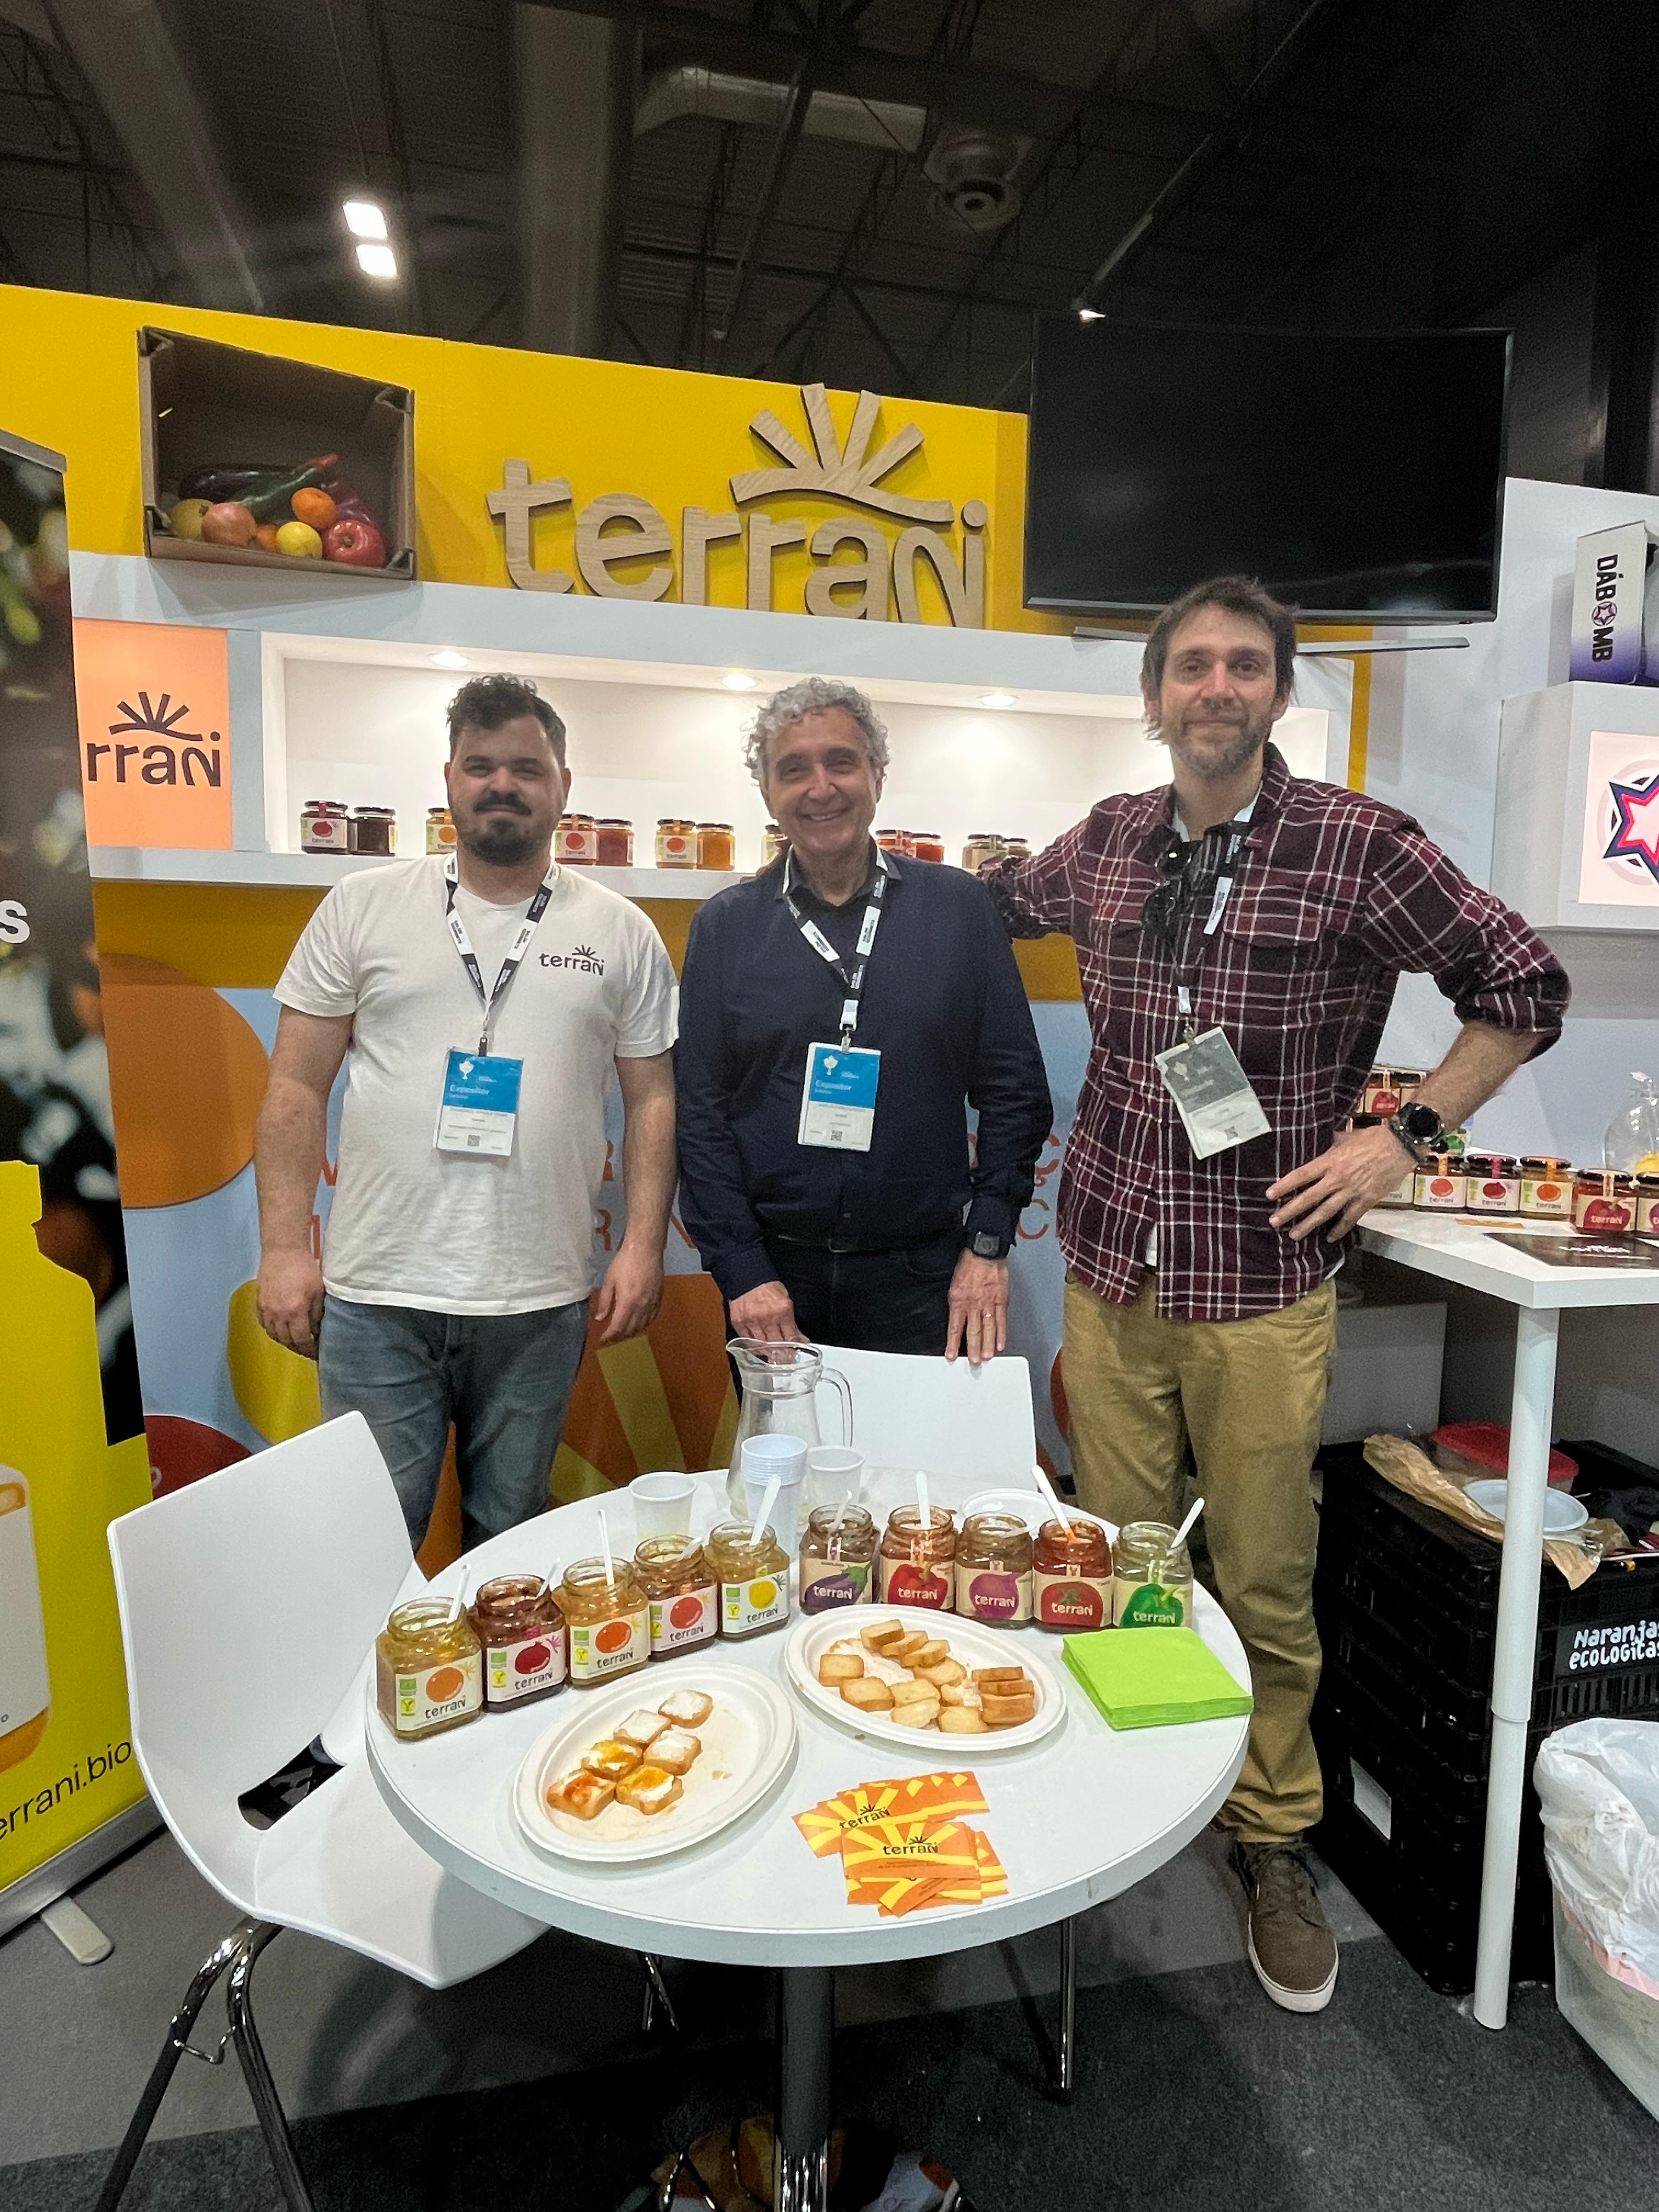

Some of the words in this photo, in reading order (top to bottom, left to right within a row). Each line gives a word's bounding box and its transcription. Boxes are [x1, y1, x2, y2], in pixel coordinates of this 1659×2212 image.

[487, 458, 988, 629] terrani
[539, 952, 604, 976] terrani
[1591, 1215, 1623, 1224] terrani
[813, 1585, 853, 1599] terrani
[898, 1588, 938, 1600] terrani
[974, 1594, 1015, 1607] terrani
[747, 1604, 778, 1622] terrani
[1051, 1602, 1093, 1616] terrani
[1133, 1610, 1176, 1624] terrani
[670, 1622, 703, 1641] terrani
[1573, 1620, 1659, 1649] Naranja
[597, 1647, 633, 1668] terrani
[515, 1668, 553, 1690] terrani
[425, 1695, 466, 1719] terrani
[883, 1842, 939, 1855] terrani
